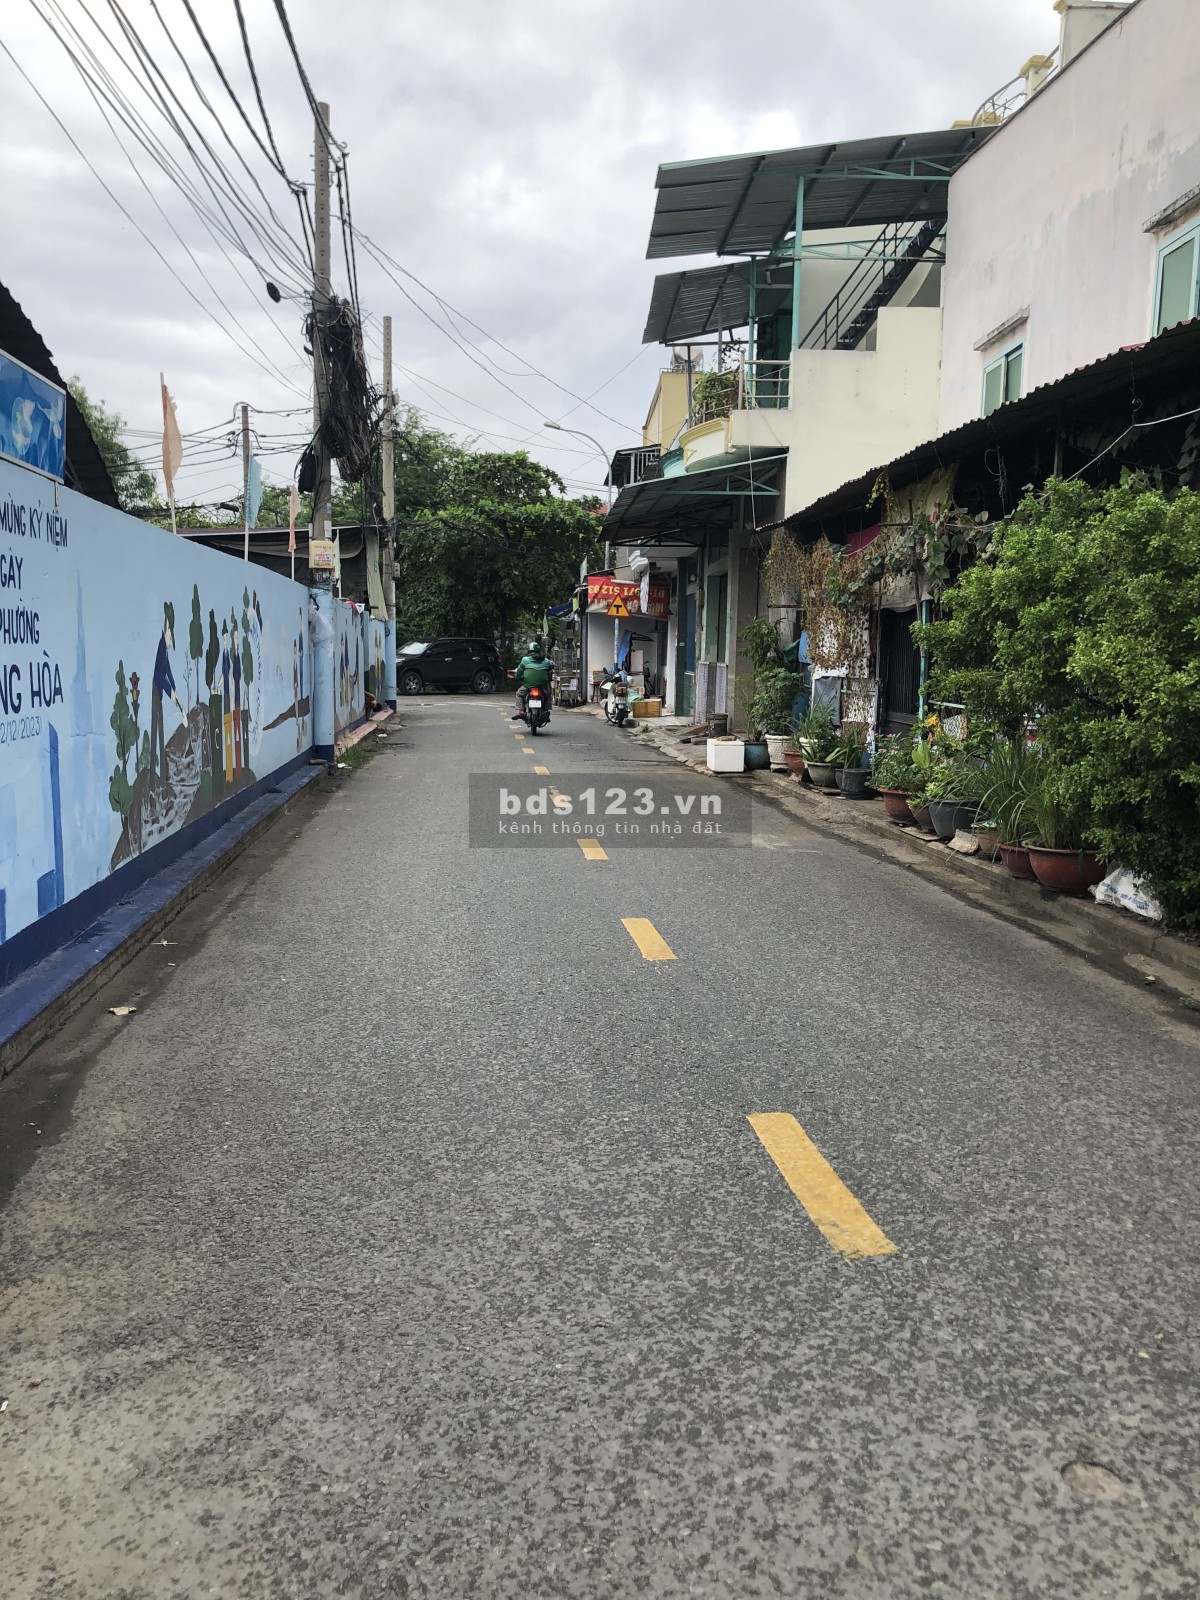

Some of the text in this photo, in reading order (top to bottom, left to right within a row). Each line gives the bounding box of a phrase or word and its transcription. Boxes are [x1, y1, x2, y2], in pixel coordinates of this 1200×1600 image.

[0, 492, 27, 537] MỪNG
[46, 509, 68, 552] NIỆM
[29, 649, 64, 709] HÒA
